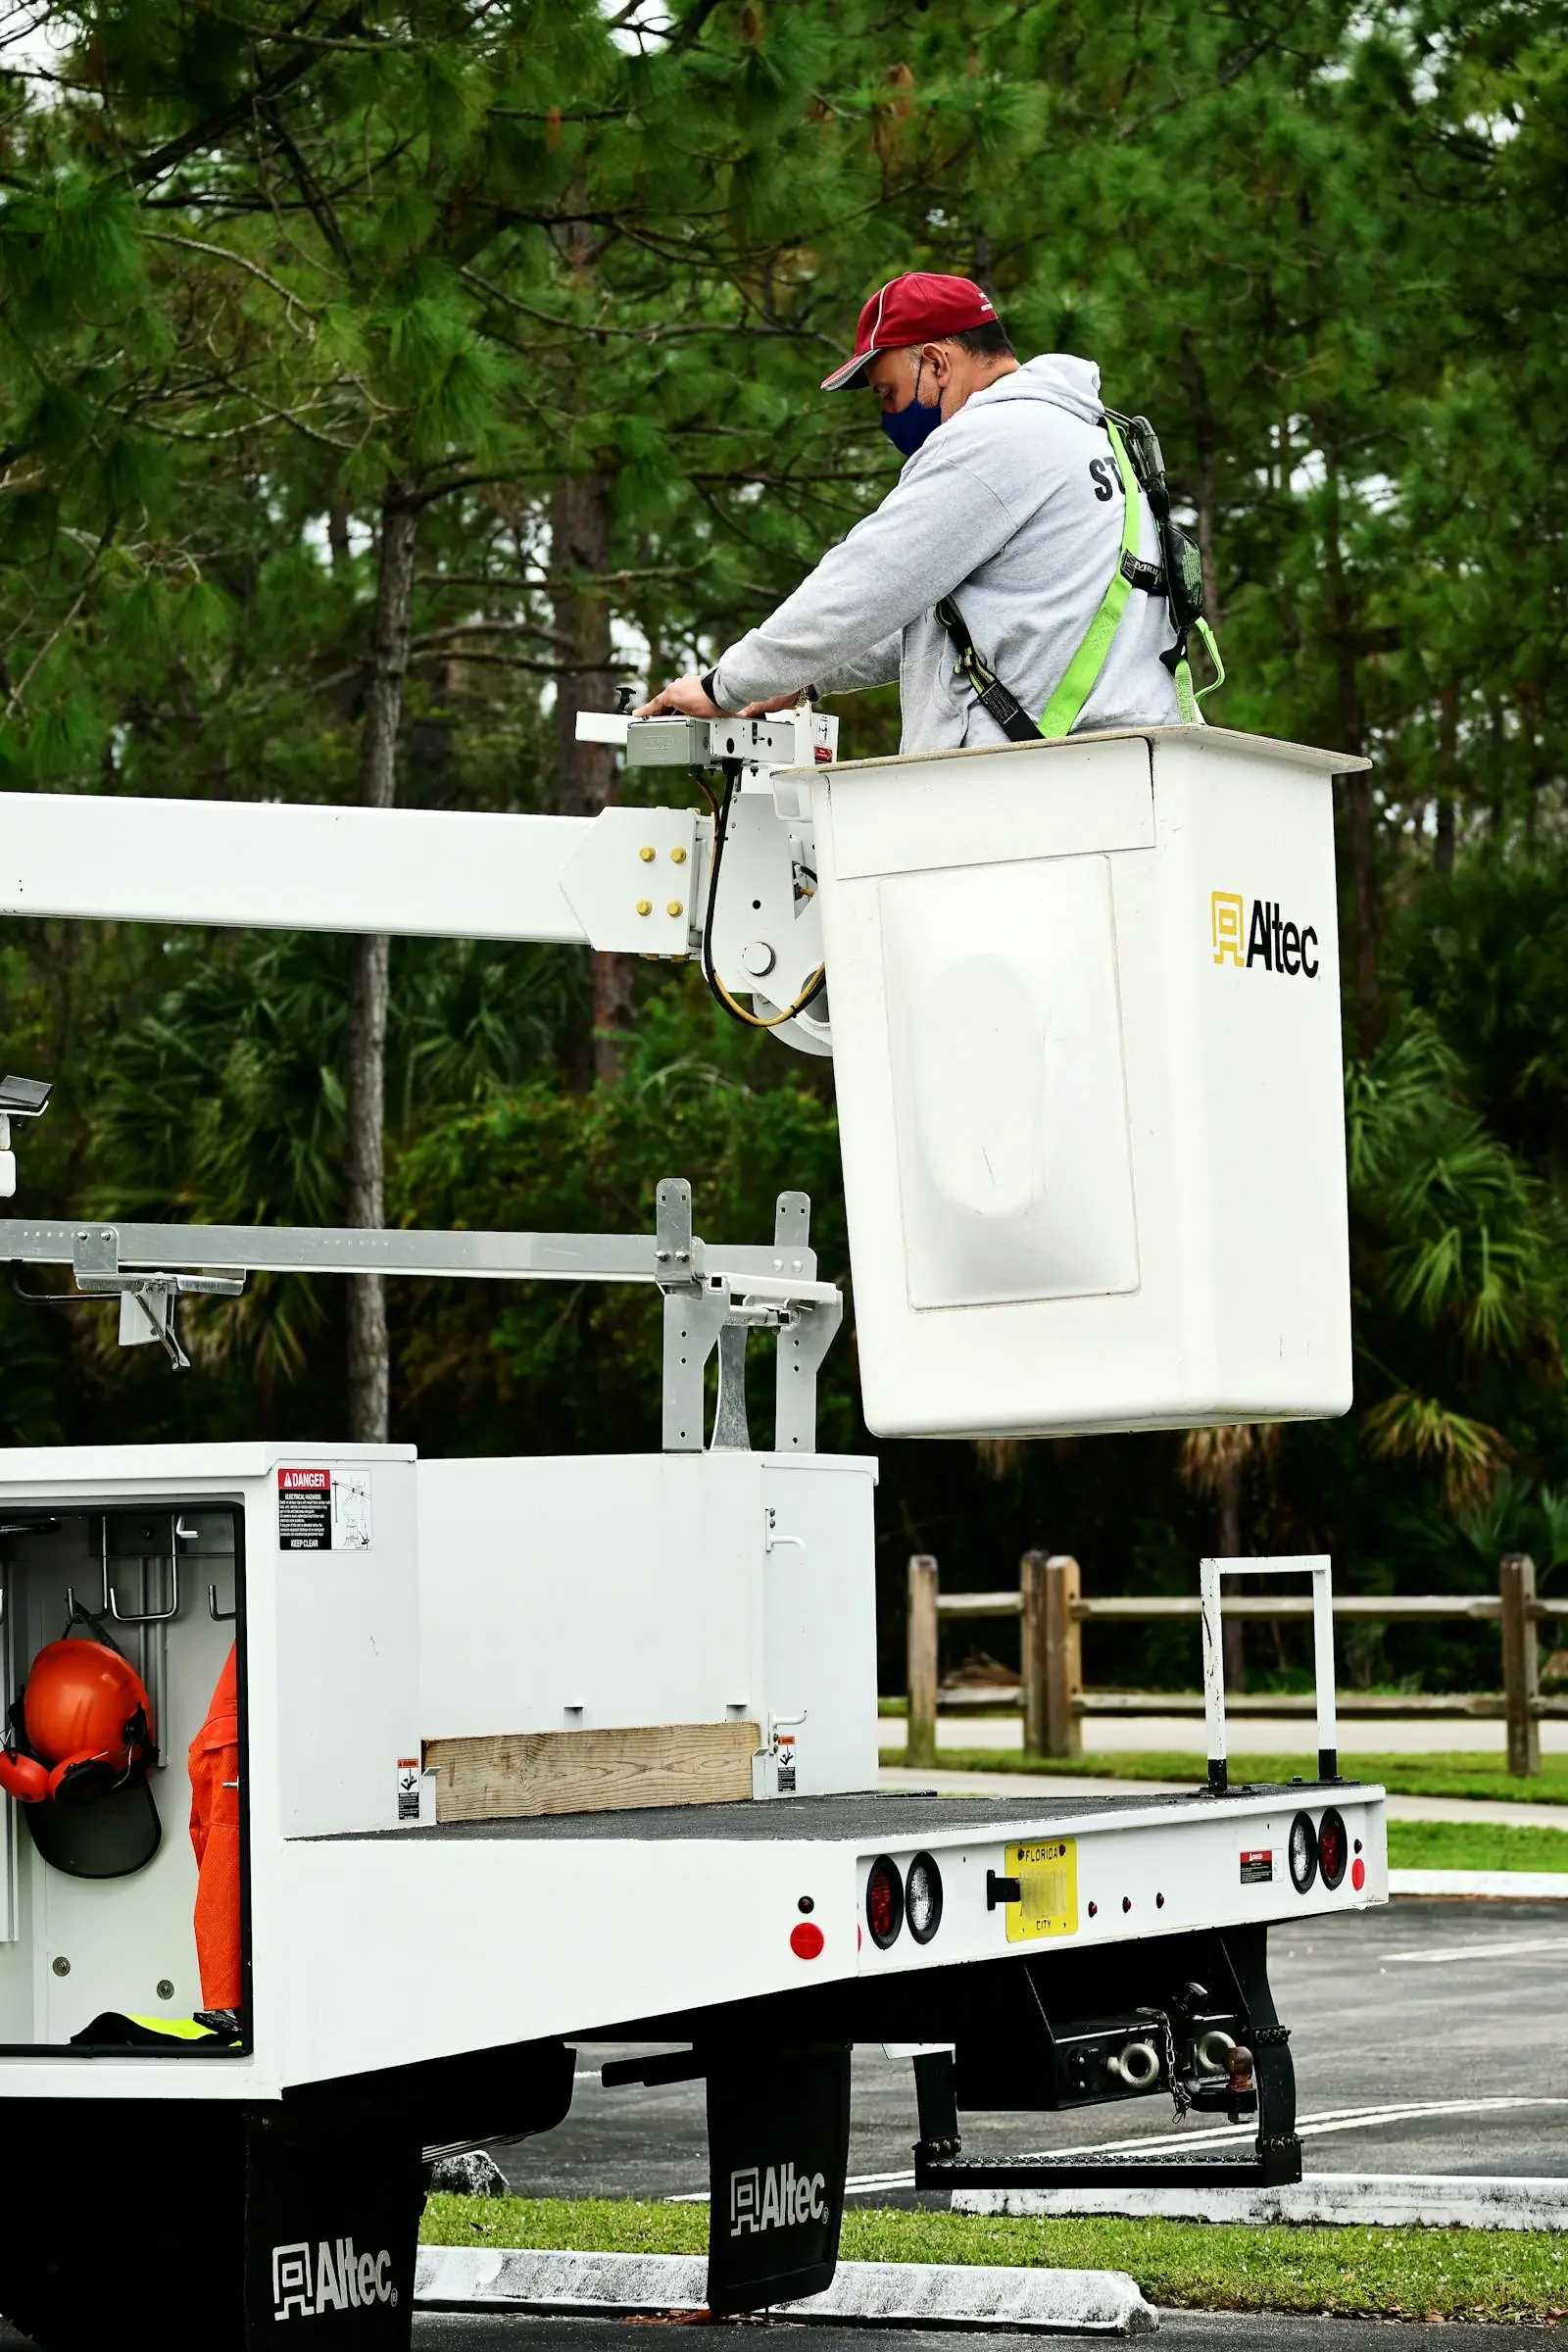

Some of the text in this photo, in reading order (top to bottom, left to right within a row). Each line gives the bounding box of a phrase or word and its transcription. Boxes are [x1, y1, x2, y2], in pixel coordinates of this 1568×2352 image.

[1247, 900, 1319, 978] Altec
[292, 1473, 325, 1488] DANGER
[290, 1539, 318, 1547] KEEP CLEAR
[1025, 1847, 1057, 1862] FLORIDA
[1036, 1920, 1051, 1931] CITY
[760, 2162, 825, 2230] Altec
[316, 2237, 392, 2314] Altec
